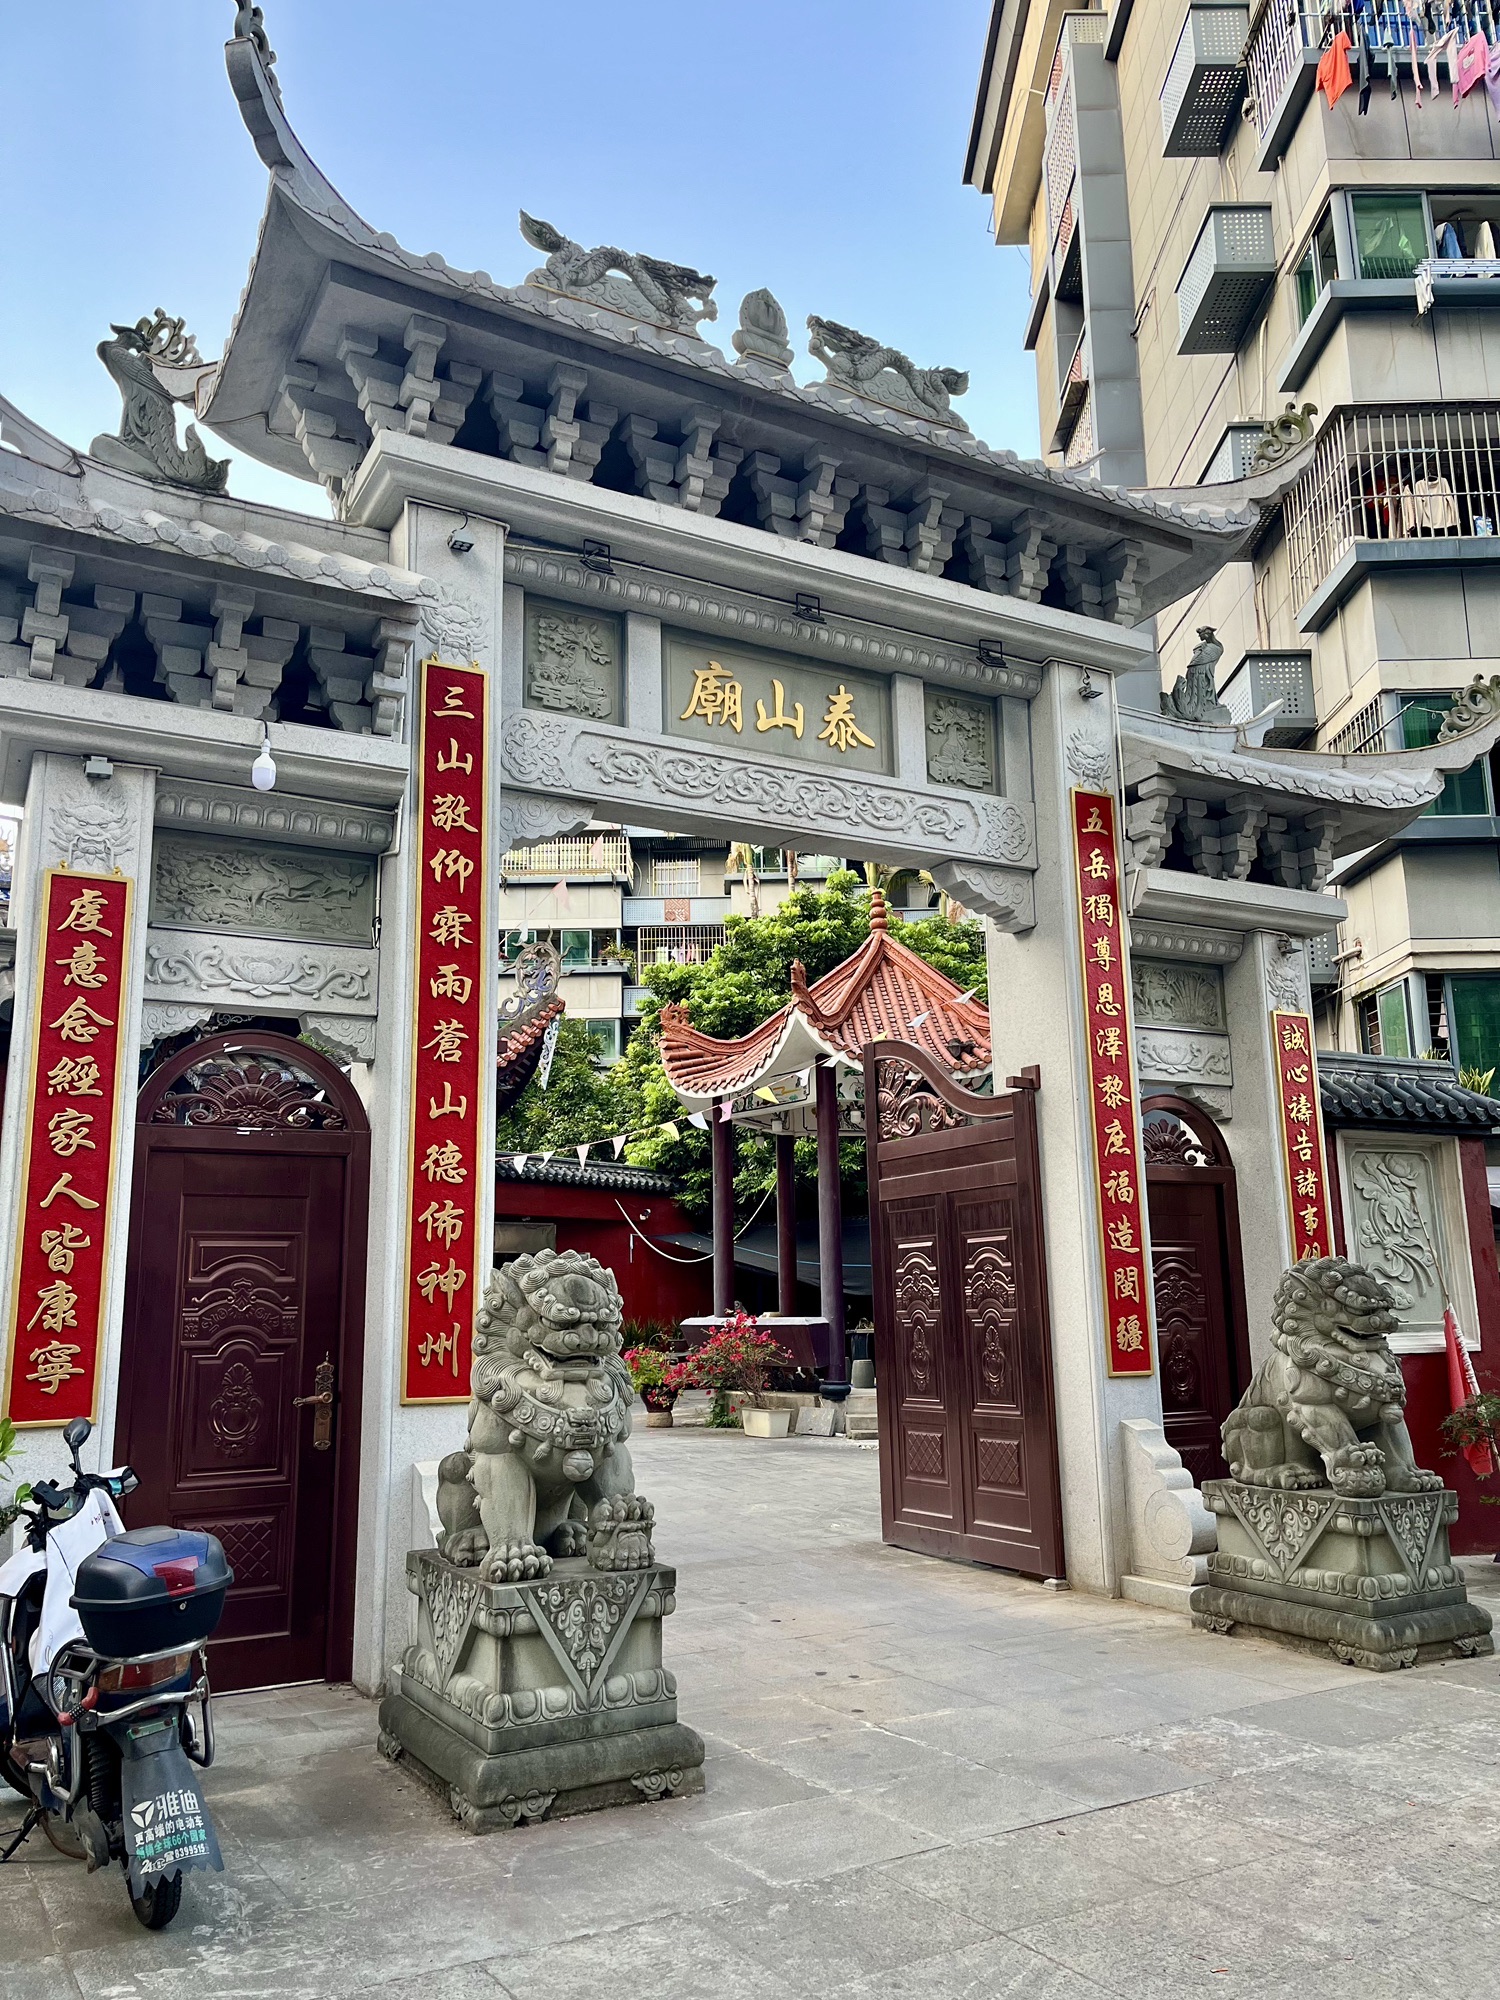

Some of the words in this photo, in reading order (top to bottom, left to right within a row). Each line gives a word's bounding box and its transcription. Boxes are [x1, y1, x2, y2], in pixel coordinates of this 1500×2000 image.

[156, 1789, 201, 1821] 雅迪
[134, 1815, 204, 1847] 更高端的电动车
[135, 1829, 207, 1861] 畅销全球66个国家
